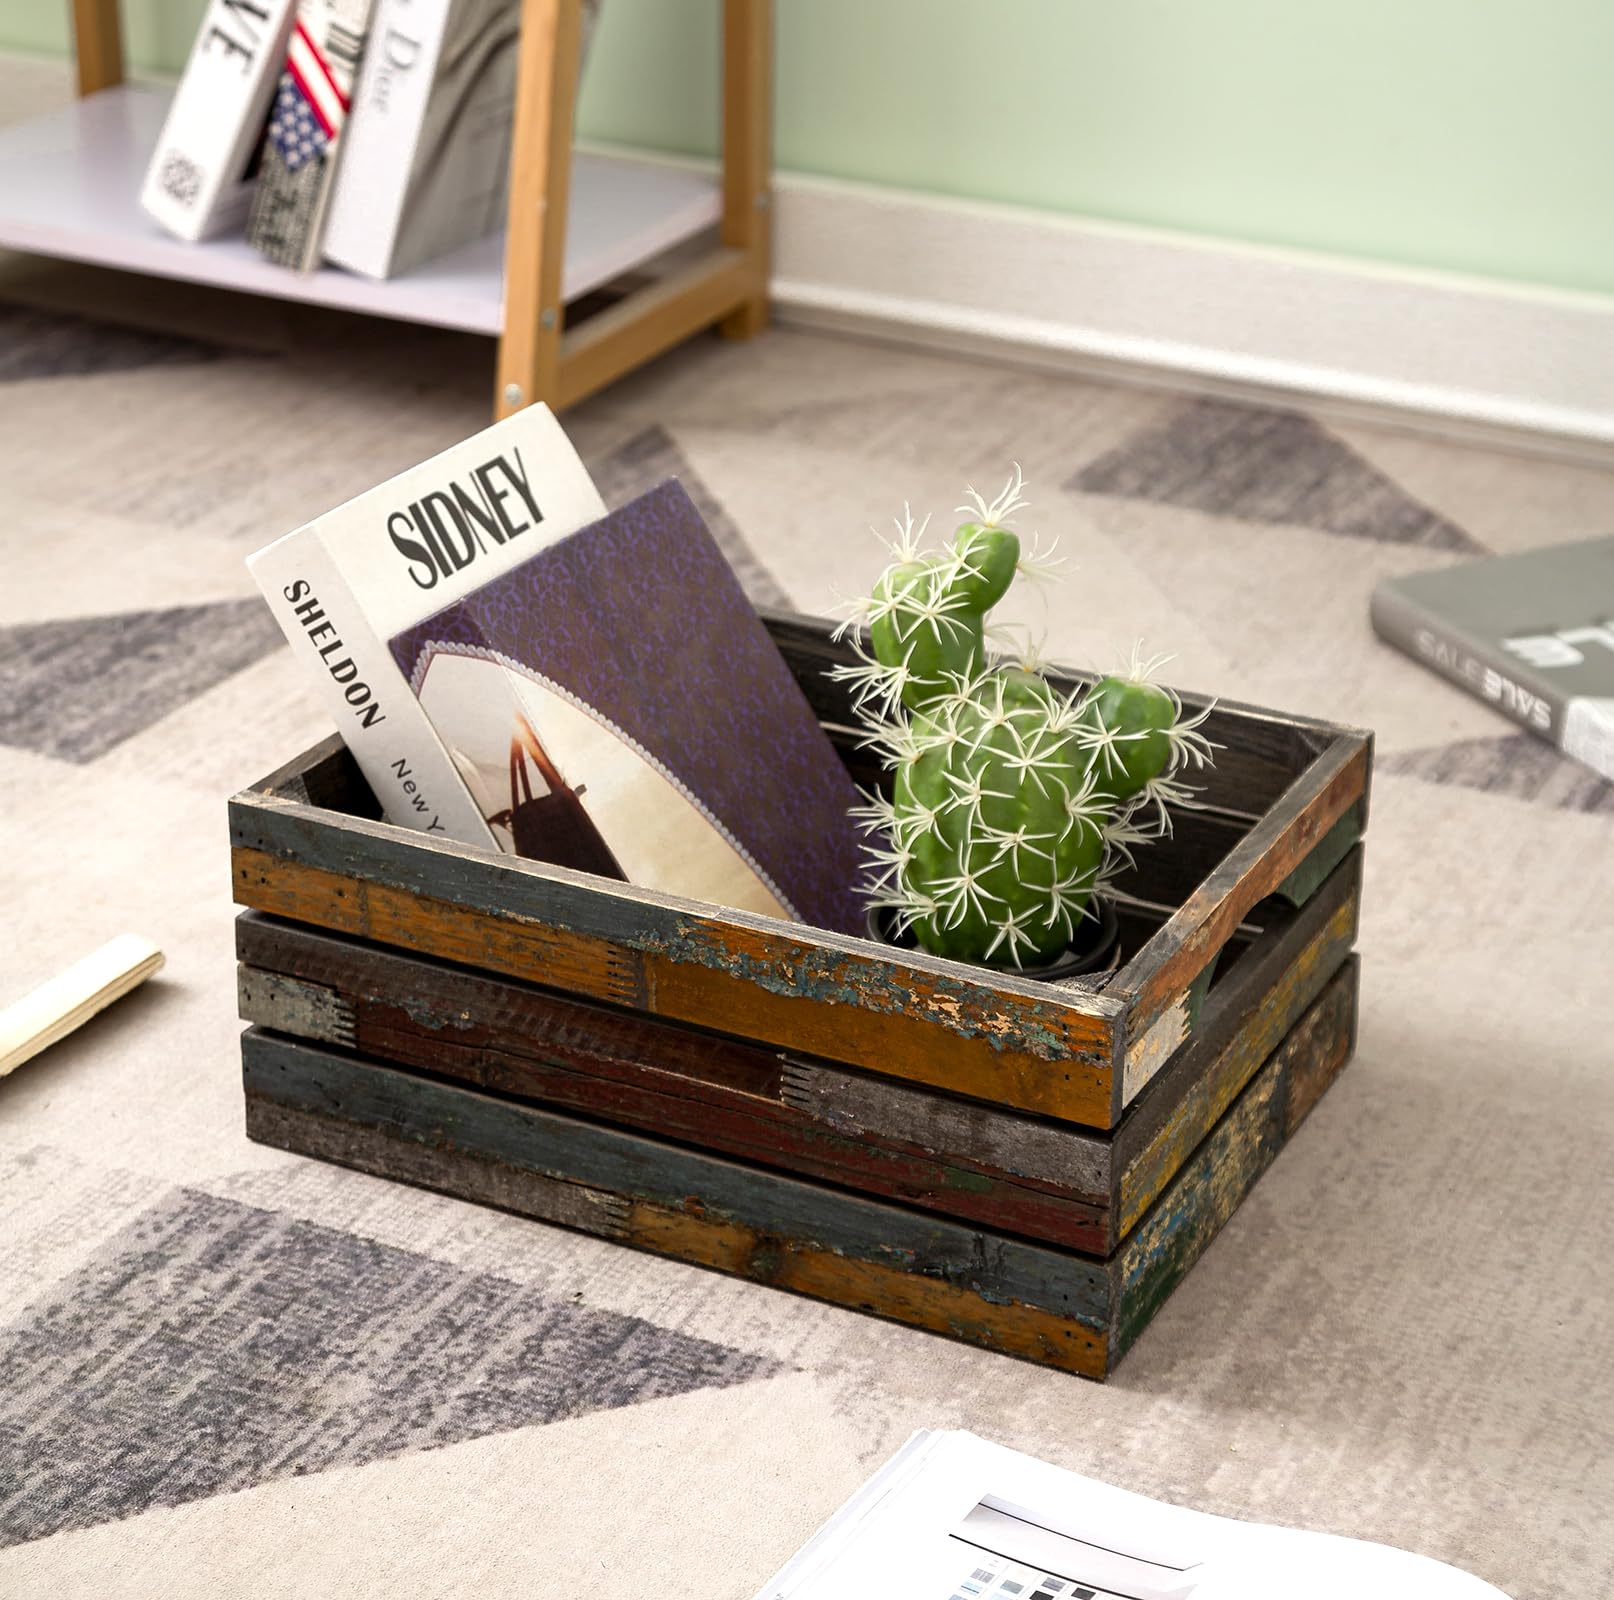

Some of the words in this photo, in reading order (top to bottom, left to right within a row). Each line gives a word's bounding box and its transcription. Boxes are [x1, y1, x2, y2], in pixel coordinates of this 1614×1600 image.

[386, 446, 545, 590] SIDNEY
[283, 578, 387, 730] SHELDON
[390, 758, 430, 812] New
